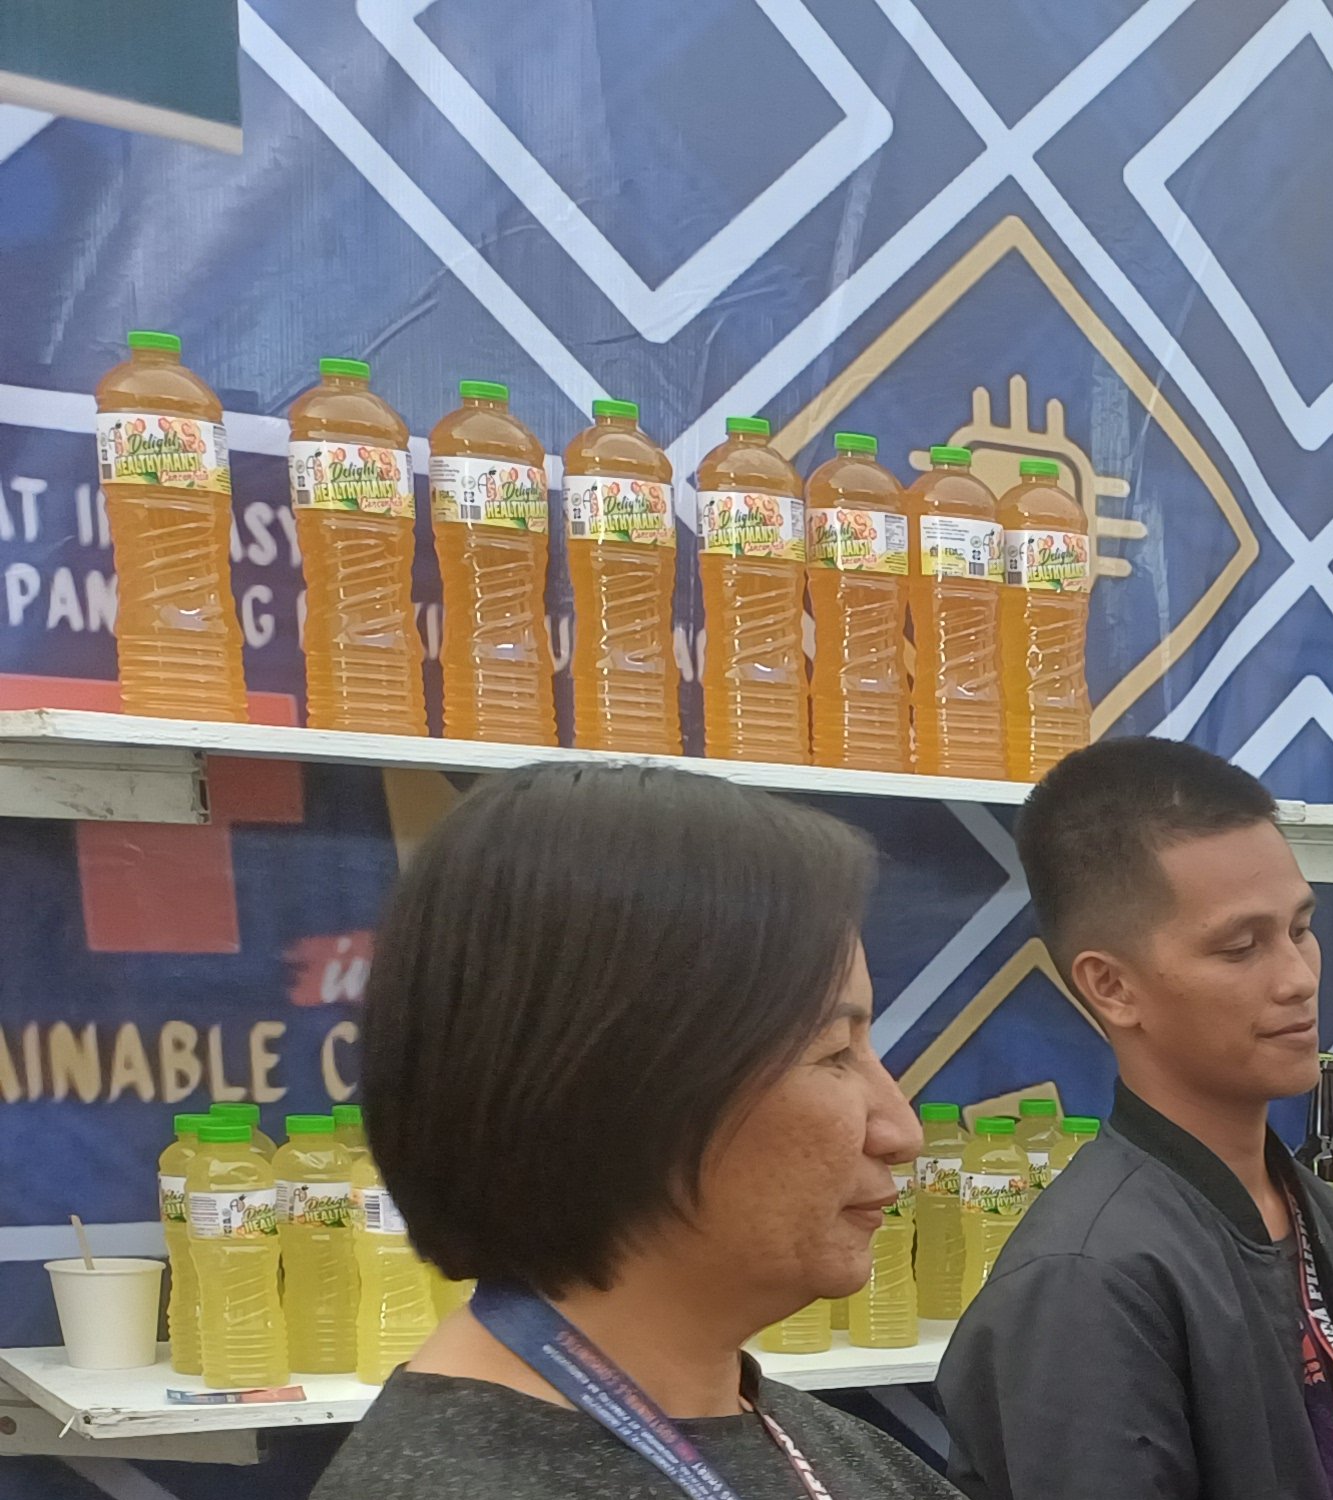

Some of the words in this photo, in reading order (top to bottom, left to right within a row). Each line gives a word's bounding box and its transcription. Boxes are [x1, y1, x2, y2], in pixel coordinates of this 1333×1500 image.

[128, 431, 182, 454] Delight
[330, 460, 378, 482] Delight
[718, 507, 763, 529] Dlight
